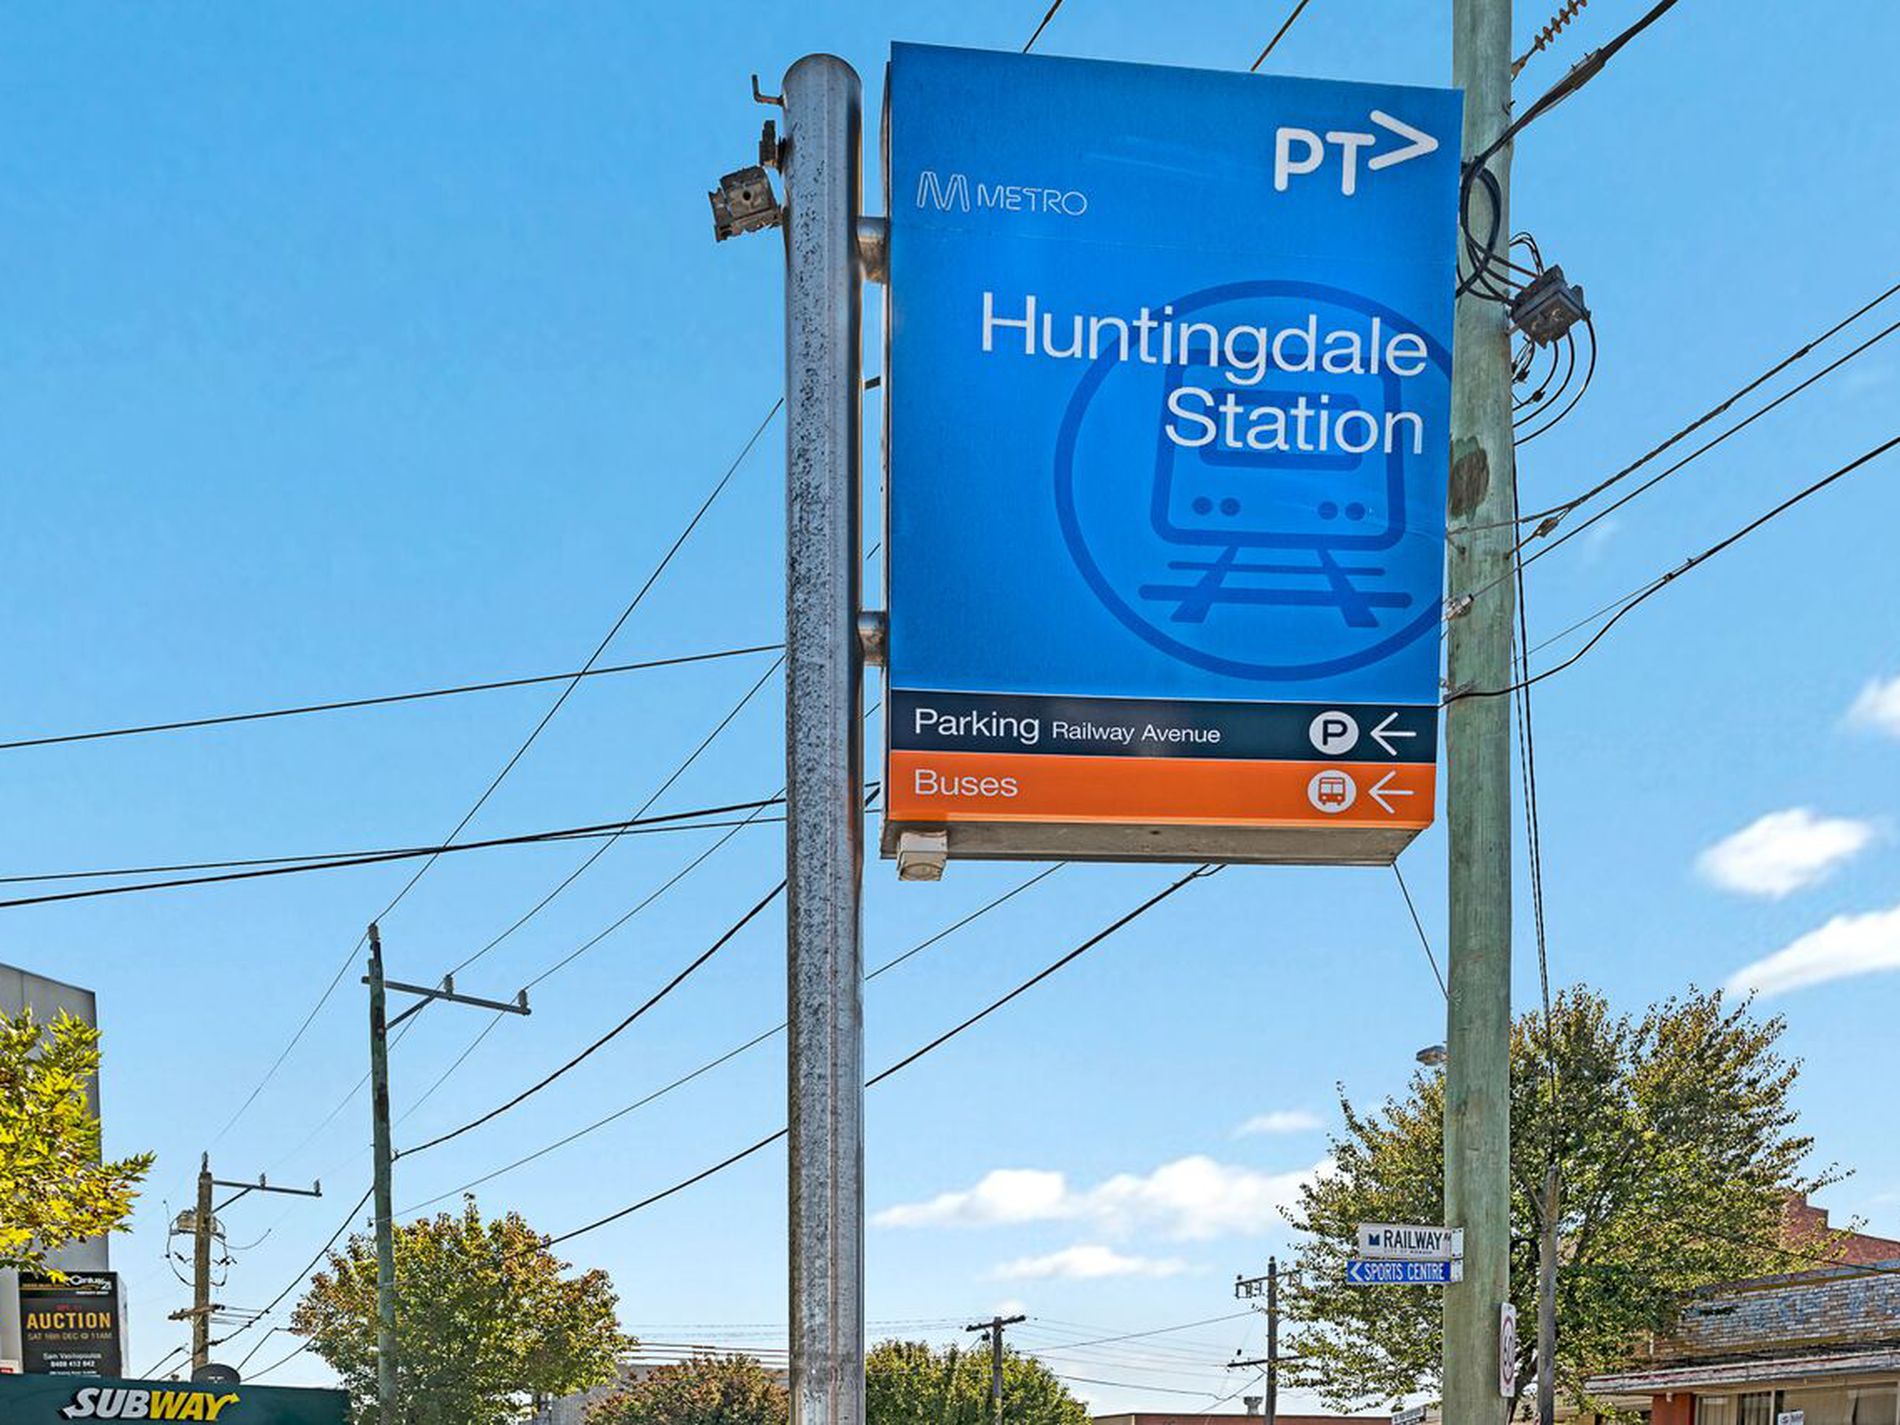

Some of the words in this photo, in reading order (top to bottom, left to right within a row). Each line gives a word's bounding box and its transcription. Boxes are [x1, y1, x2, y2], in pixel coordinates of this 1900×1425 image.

[976, 183, 1088, 217] METRO
[981, 291, 1429, 386] Huntingdale
[1164, 386, 1424, 456] Station
[914, 707, 1040, 746] Parking
[1051, 720, 1136, 746] Railway
[1141, 722, 1221, 744] Avenue
[914, 768, 1019, 798] Buses
[1383, 1229, 1442, 1251] RAILWAY
[1363, 1262, 1403, 1281] SPORTS
[1407, 1262, 1445, 1281] CENTRE
[26, 1312, 111, 1330] AUCTION
[62, 1332, 79, 1341] DEC
[61, 1387, 241, 1422] SUBWAY
